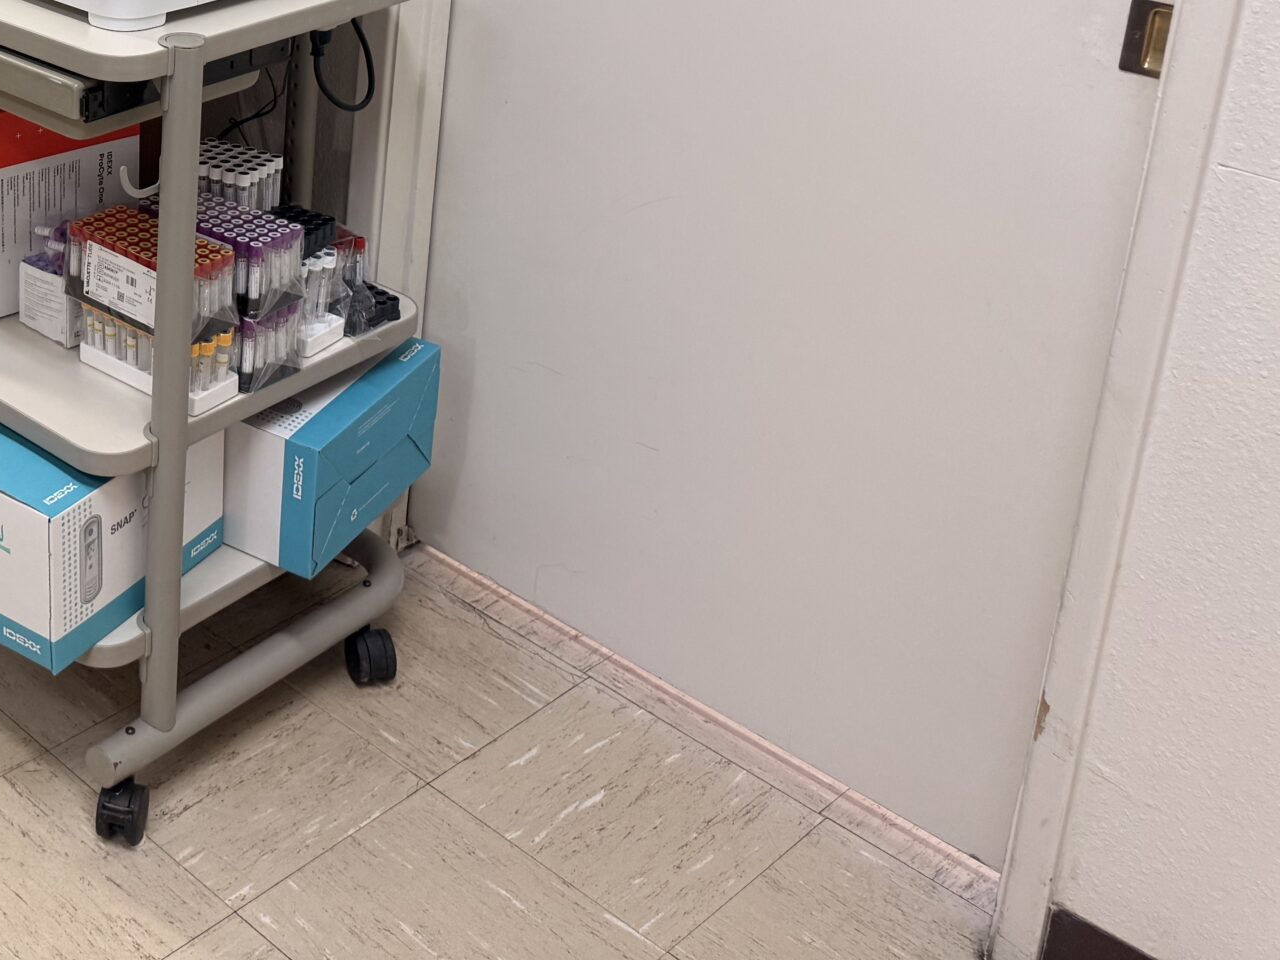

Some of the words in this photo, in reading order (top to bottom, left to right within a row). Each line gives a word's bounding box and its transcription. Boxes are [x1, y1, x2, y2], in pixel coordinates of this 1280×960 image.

[399, 342, 425, 362] IDEXX
[293, 456, 304, 500] IDEXX
[43, 482, 79, 506] IDEXX
[110, 511, 135, 535] SNAP
[190, 529, 218, 558] IDEXX
[3, 626, 42, 655] IDEXX
